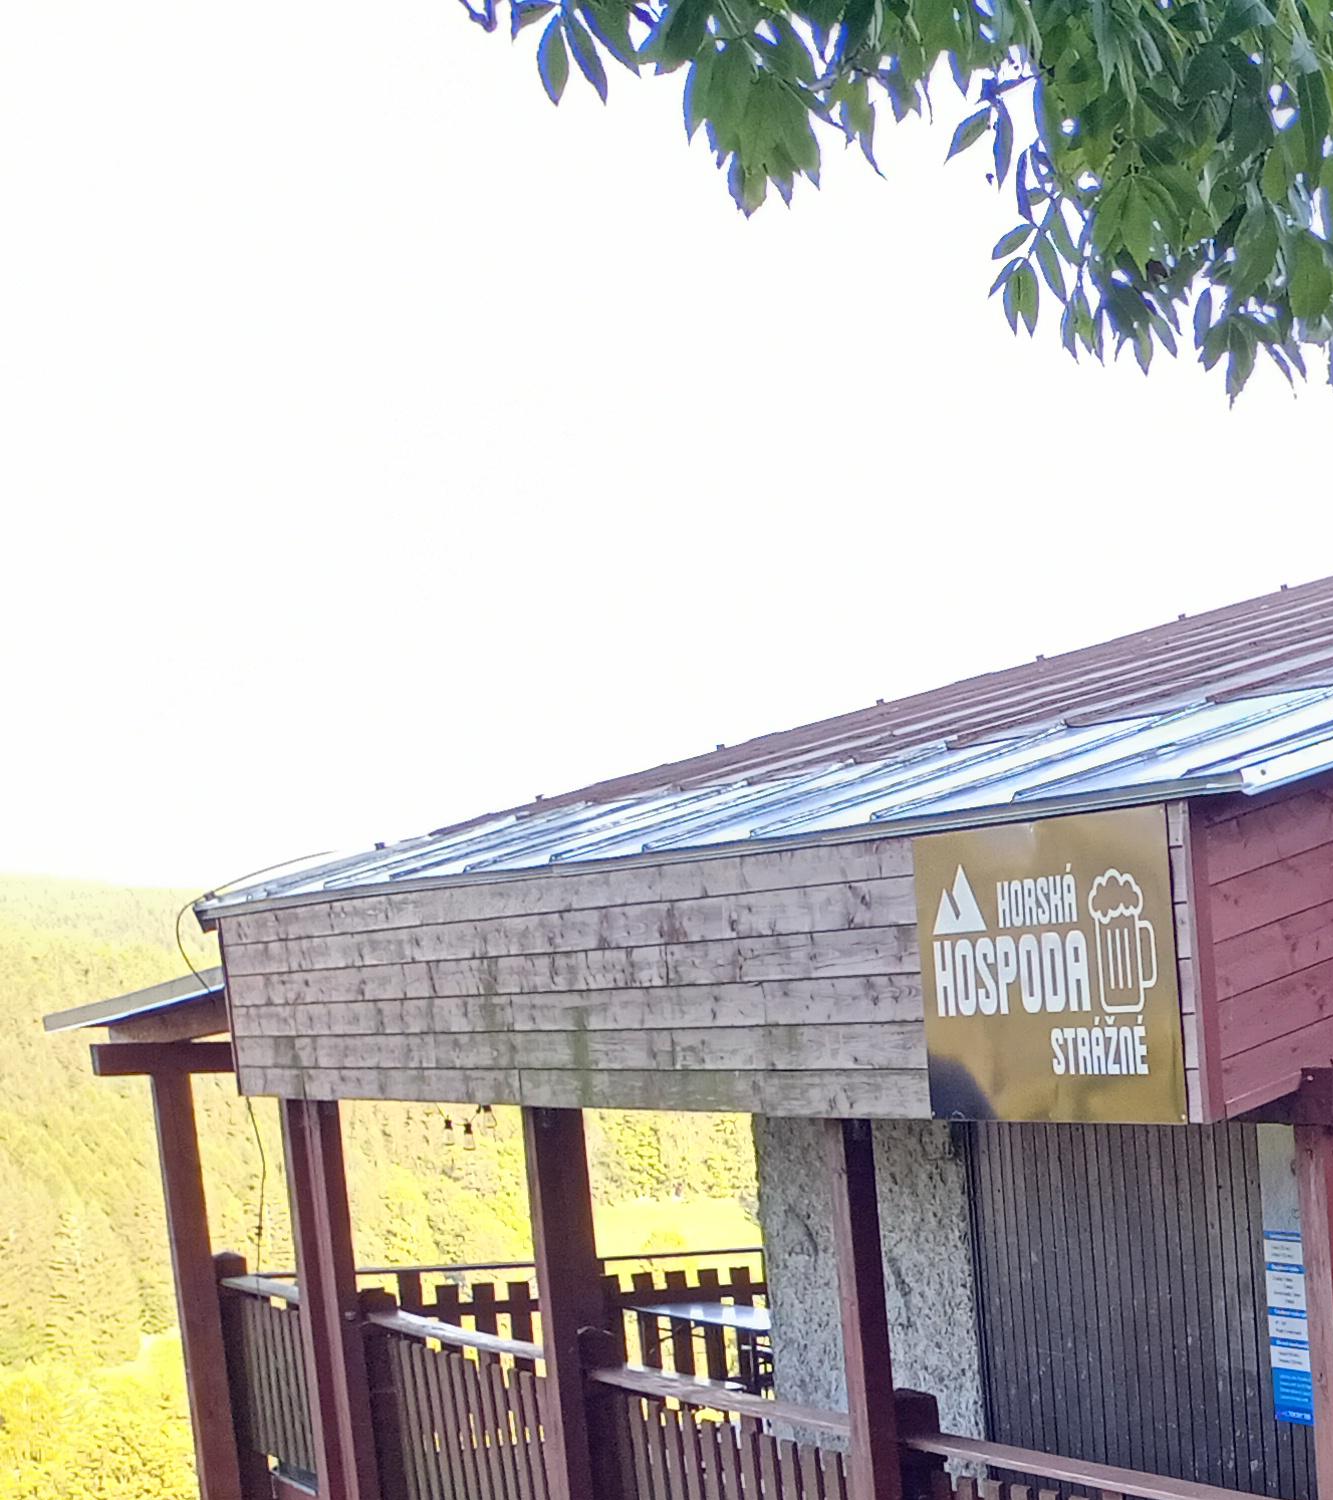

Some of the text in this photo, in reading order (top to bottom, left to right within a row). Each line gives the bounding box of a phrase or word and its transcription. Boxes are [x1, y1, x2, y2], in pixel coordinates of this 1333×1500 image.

[997, 863, 1078, 928] HORSKÁ
[933, 930, 1092, 1017] HOSPODA
[1050, 1015, 1149, 1075] STRÁŽNÉ
